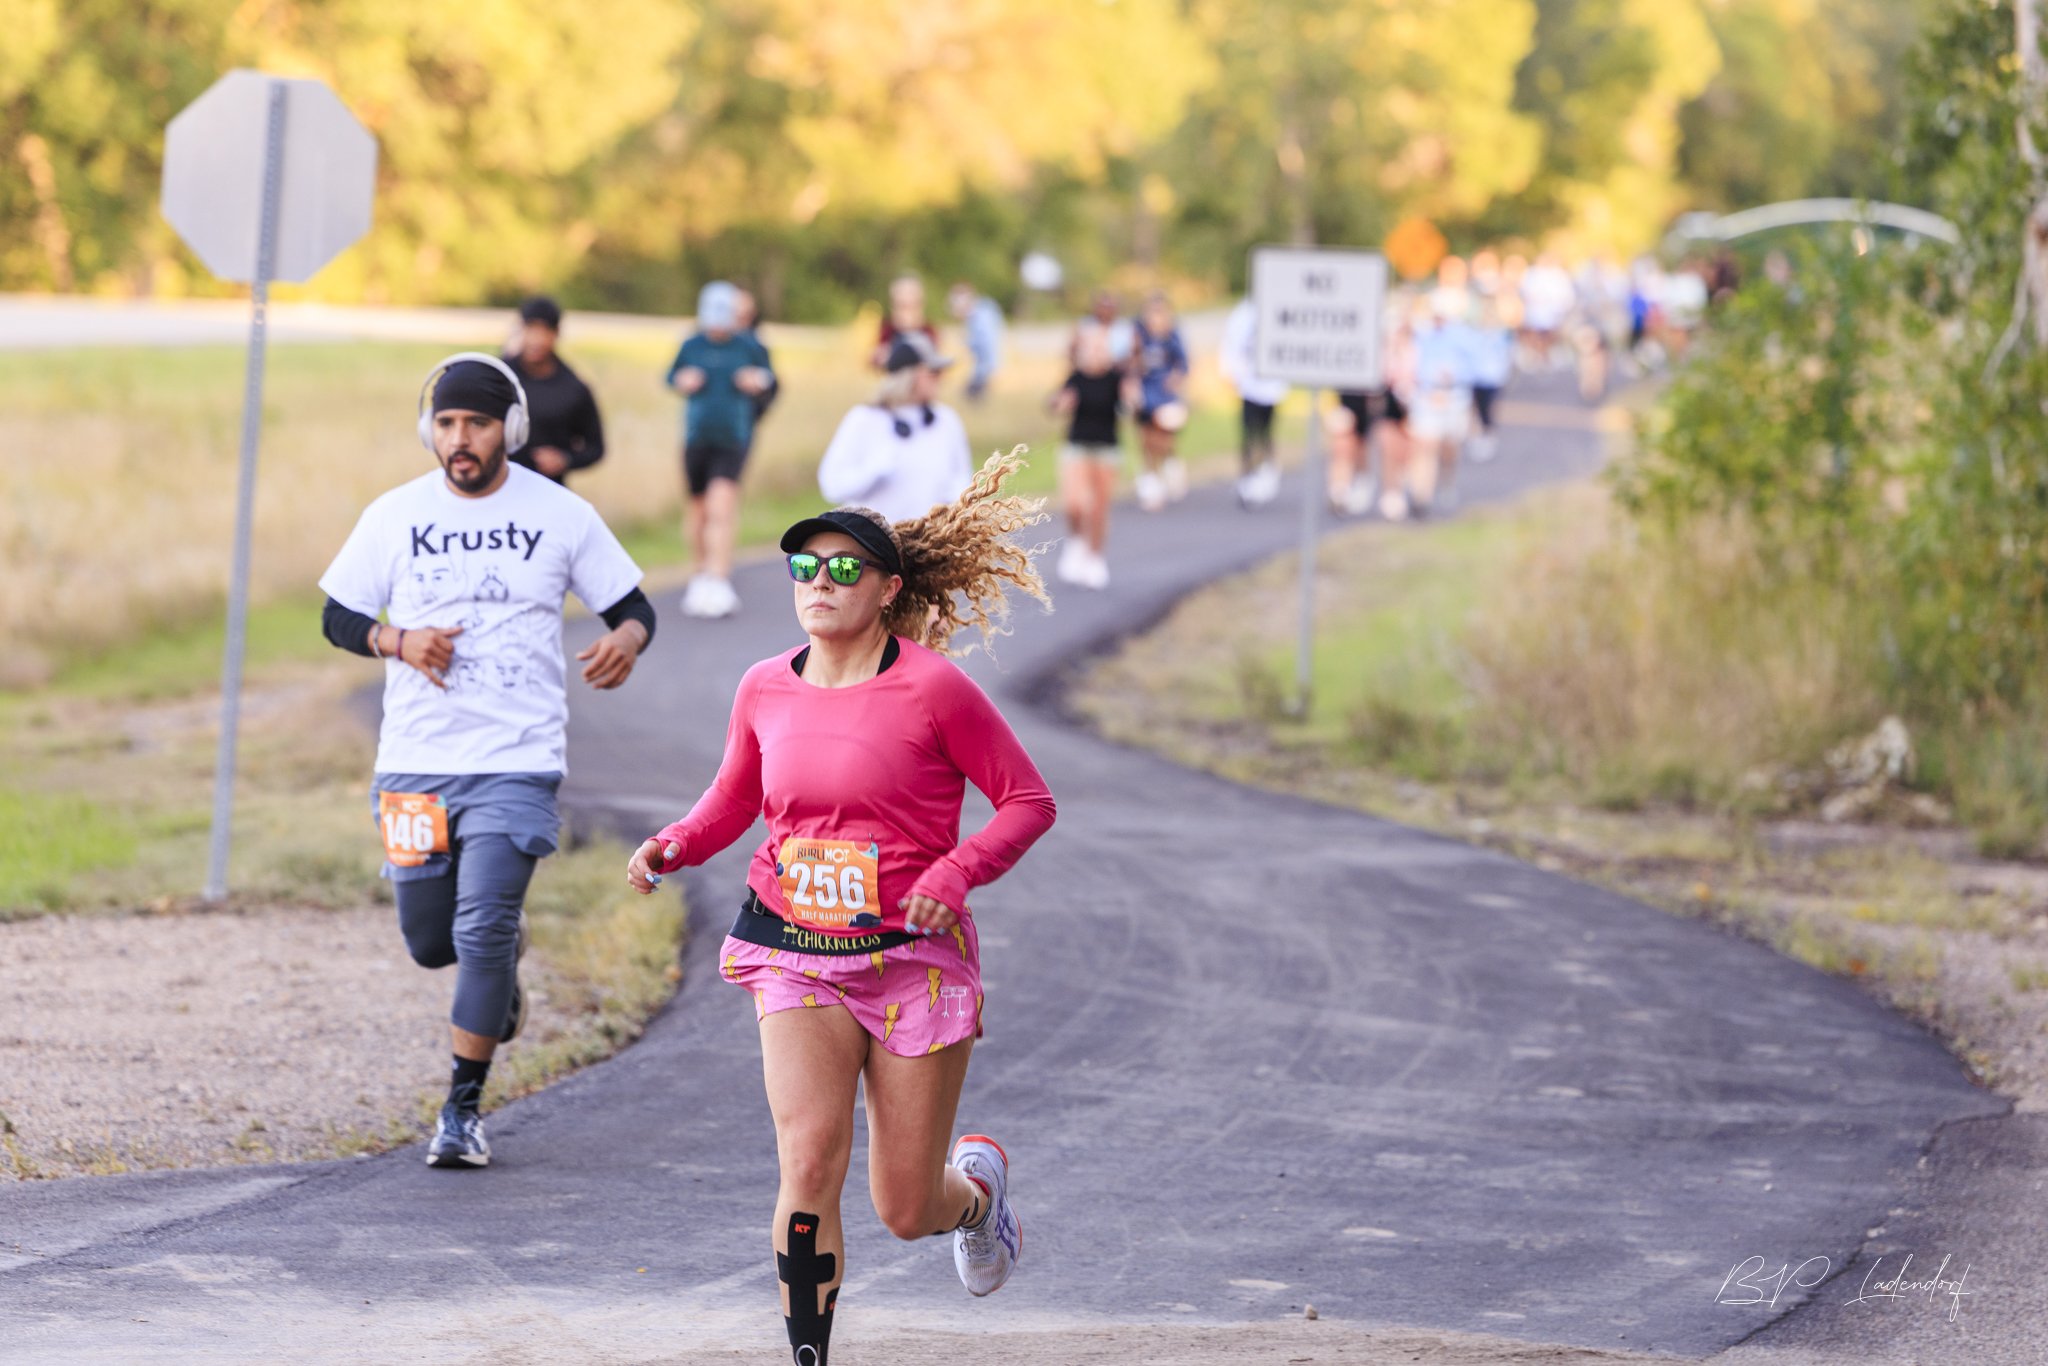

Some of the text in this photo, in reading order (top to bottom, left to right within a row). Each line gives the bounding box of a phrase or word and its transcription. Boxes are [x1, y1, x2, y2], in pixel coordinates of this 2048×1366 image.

[1303, 272, 1336, 295] NO
[1277, 307, 1360, 332] MOTOR
[411, 521, 543, 561] Krusty
[383, 812, 434, 852] 146
[789, 862, 867, 910] 256
[801, 910, 857, 924] HALF MARATHON
[794, 1223, 811, 1234] KT
